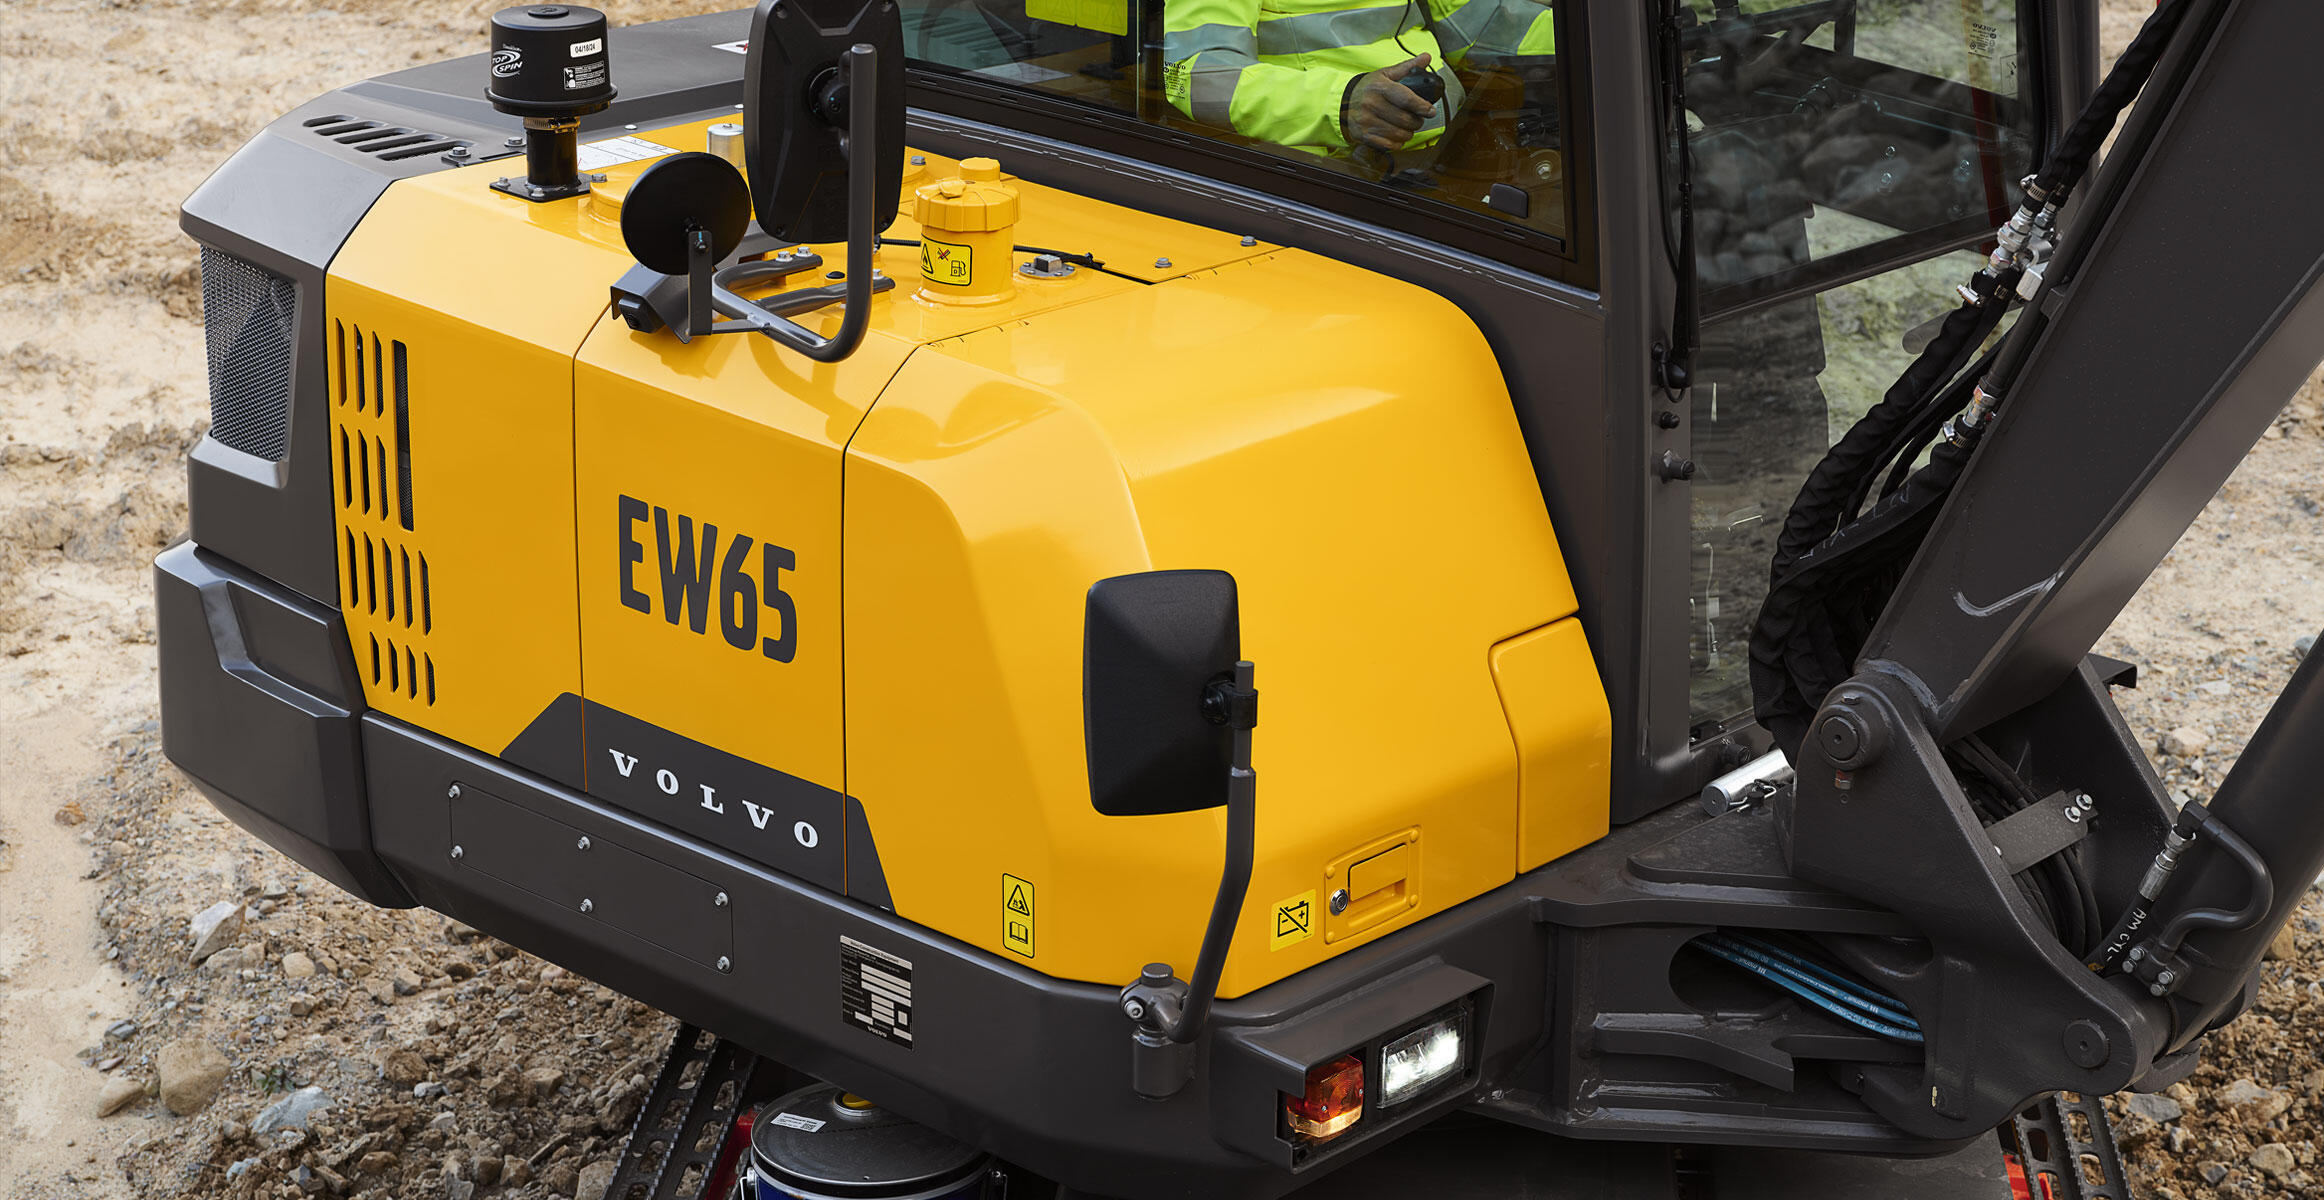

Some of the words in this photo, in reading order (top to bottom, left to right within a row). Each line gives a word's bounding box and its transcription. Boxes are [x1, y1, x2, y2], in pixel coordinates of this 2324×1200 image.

[492, 55, 508, 65] TOP
[498, 61, 523, 73] SPIN
[618, 493, 798, 664] EW65
[608, 748, 819, 849] VOLVO
